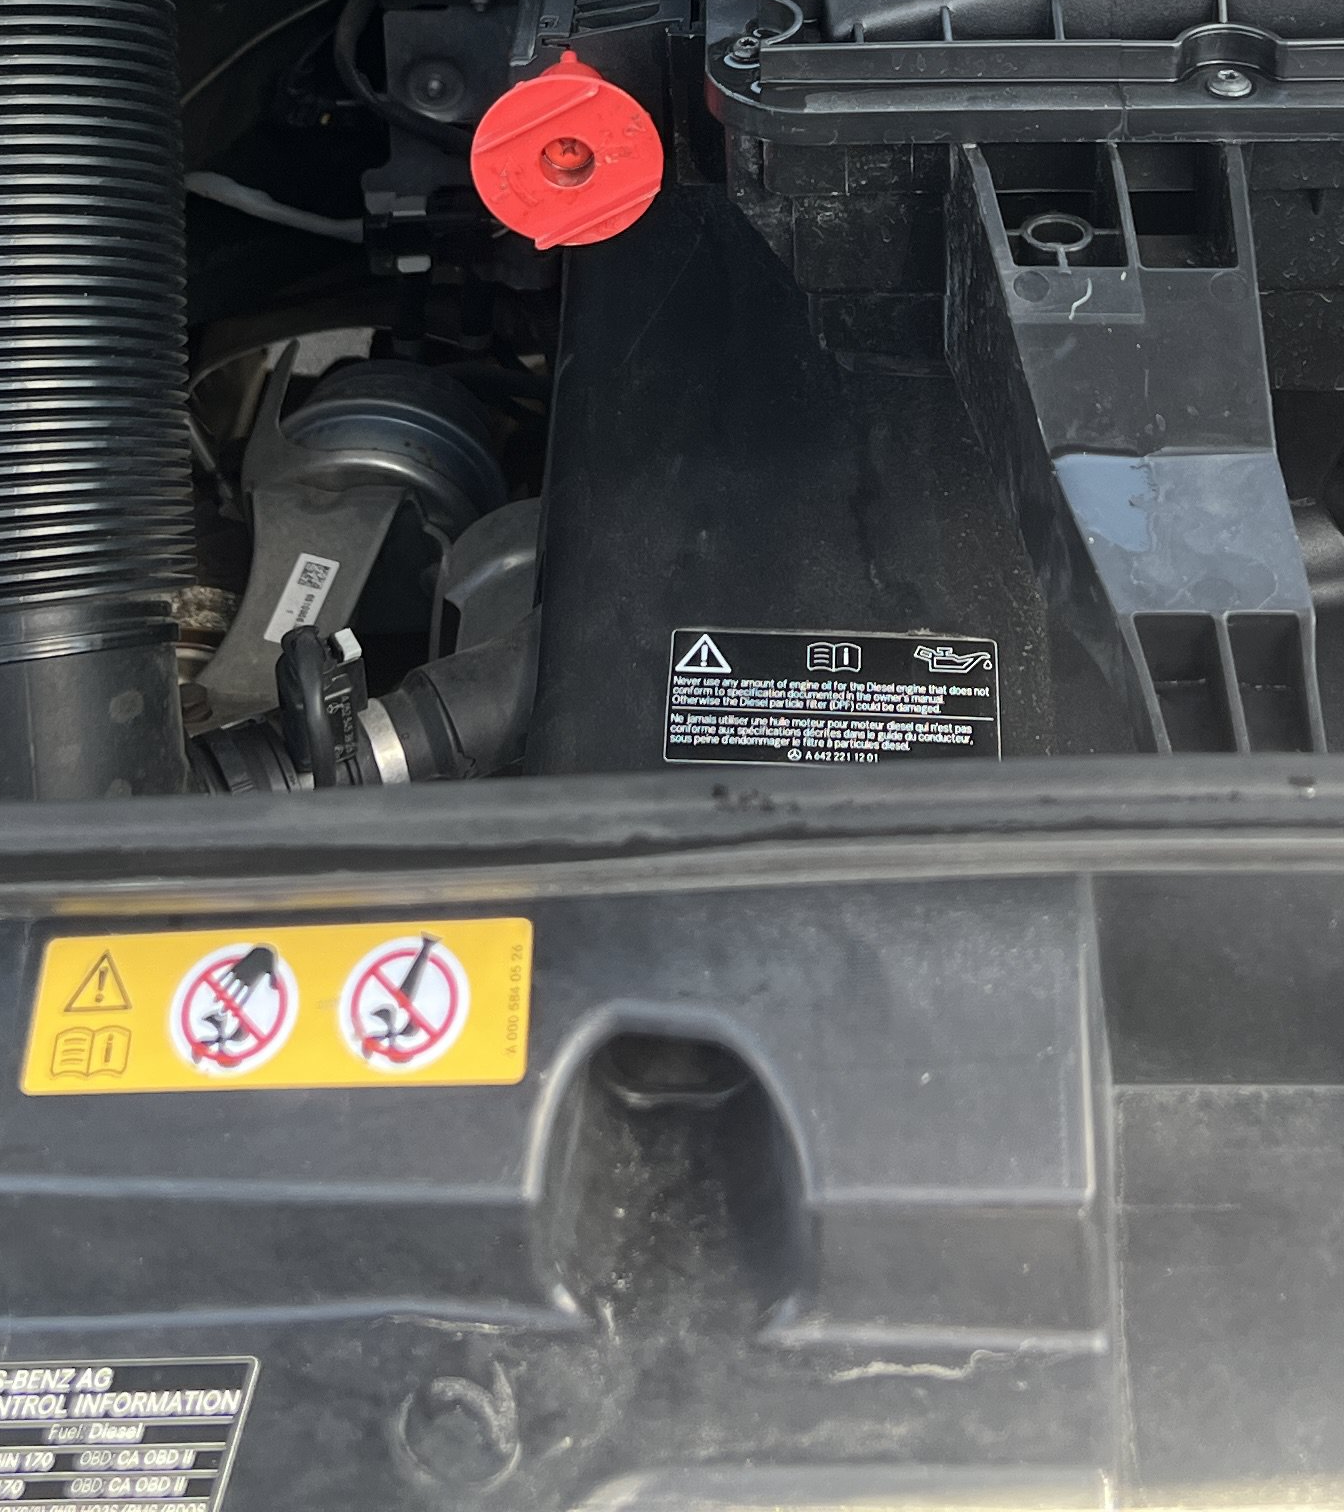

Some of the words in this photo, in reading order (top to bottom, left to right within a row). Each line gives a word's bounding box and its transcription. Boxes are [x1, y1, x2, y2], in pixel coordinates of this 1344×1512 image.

[673, 676, 702, 686] Never
[703, 678, 719, 687] use
[722, 678, 738, 689] any
[741, 679, 774, 689] amount
[777, 679, 787, 689] of
[789, 681, 819, 691] engine
[821, 681, 832, 690] oil
[834, 681, 847, 690] for
[850, 682, 865, 691] the
[867, 682, 895, 693] Diesel
[896, 684, 926, 695] engine
[929, 684, 947, 694] that
[949, 686, 973, 696] does
[974, 687, 989, 697] not
[673, 686, 712, 695] conform
[715, 686, 725, 695] to
[727, 687, 786, 699] specification
[787, 689, 844, 700] documented
[846, 691, 854, 700] in
[857, 692, 871, 701] the
[873, 693, 909, 703] owner's
[911, 695, 945, 704] manual.
[672, 695, 720, 706] Otherwise
[723, 696, 738, 706] the
[740, 697, 768, 707] Diesel
[769, 699, 804, 709] particle
[806, 699, 827, 709] filter
[830, 701, 854, 712] (DPF)
[856, 701, 880, 711] could
[882, 702, 894, 711] be
[896, 704, 941, 714] damaged.
[670, 713, 684, 723] Ne
[686, 714, 716, 725] jamais
[718, 715, 748, 725] utiliser
[751, 717, 768, 726] une
[769, 716, 790, 726] huile
[792, 717, 825, 727] moteur
[828, 721, 848, 731] pour
[851, 720, 884, 730] moteur
[887, 721, 913, 731] diesel
[915, 723, 929, 733] qui
[930, 723, 952, 732] n'est
[955, 725, 973, 734] pas
[670, 724, 716, 734] conforme
[718, 726, 735, 735] aux
[737, 726, 801, 738] spécifications
[803, 728, 841, 738] décrites
[844, 730, 865, 739] dans
[867, 730, 875, 739] le
[878, 731, 903, 742] guide
[905, 732, 916, 741] du
[918, 733, 974, 745] conducteur,
[670, 734, 692, 744] sous
[694, 736, 719, 746] peine
[721, 736, 790, 748] d'endommager
[792, 736, 801, 747] le
[803, 737, 824, 747] filtre
[834, 740, 879, 750] particules
[881, 741, 911, 751] diesel.
[805, 752, 813, 761] A
[814, 752, 832, 761] 642
[833, 753, 850, 761] 221
[855, 753, 864, 762] 12
[867, 753, 879, 763] 01
[76, 1366, 113, 1388] AG
[73, 1389, 242, 1415] INFORMATION
[47, 1424, 86, 1440] Fuel:
[87, 1422, 145, 1440] Diesel
[23, 1450, 55, 1467] 170
[79, 1450, 115, 1467] OBD:
[116, 1450, 139, 1466] CA
[143, 1449, 180, 1465] OBD
[70, 1478, 105, 1496] OBD:
[107, 1478, 130, 1495] CA
[132, 1477, 170, 1494] OBD
